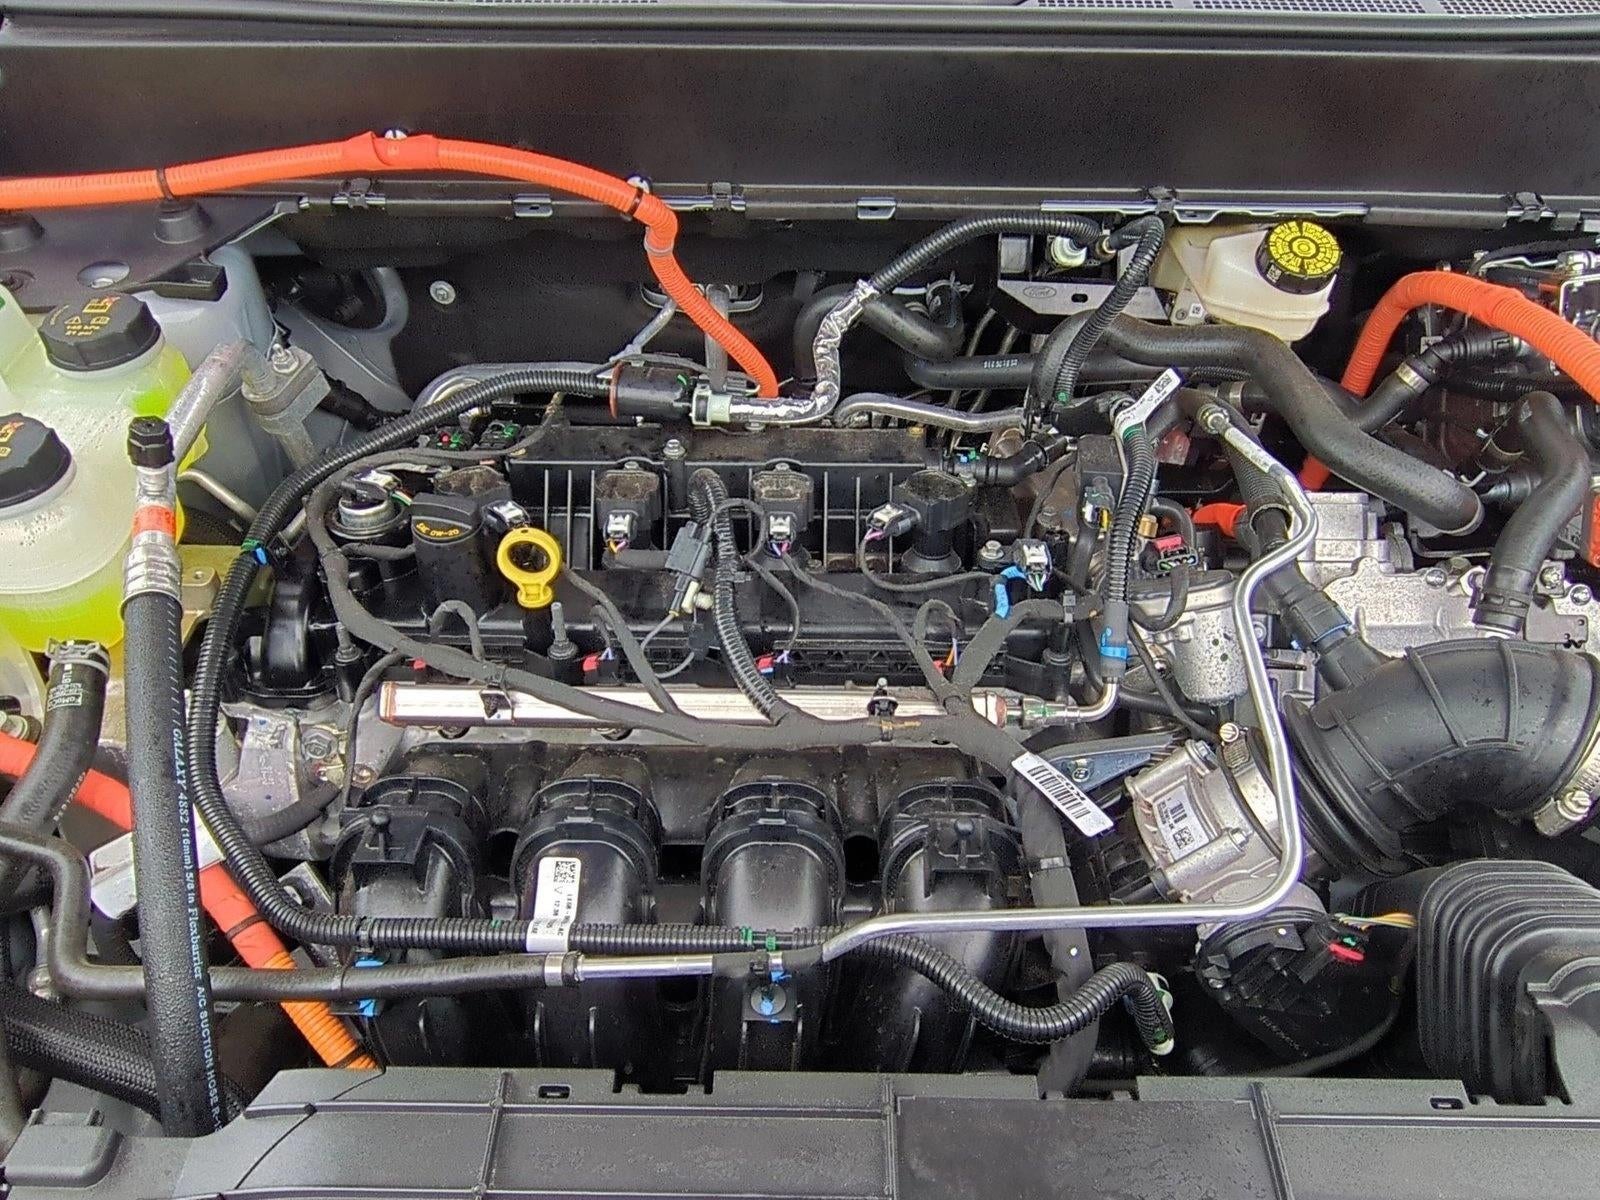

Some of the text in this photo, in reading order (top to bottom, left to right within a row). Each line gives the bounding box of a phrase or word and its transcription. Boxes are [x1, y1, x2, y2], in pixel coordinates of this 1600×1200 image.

[172, 728, 188, 791] GALAXY
[181, 827, 194, 870] (16mm)
[200, 1010, 214, 1068] SUCTION
[207, 1069, 219, 1106] HOSE
